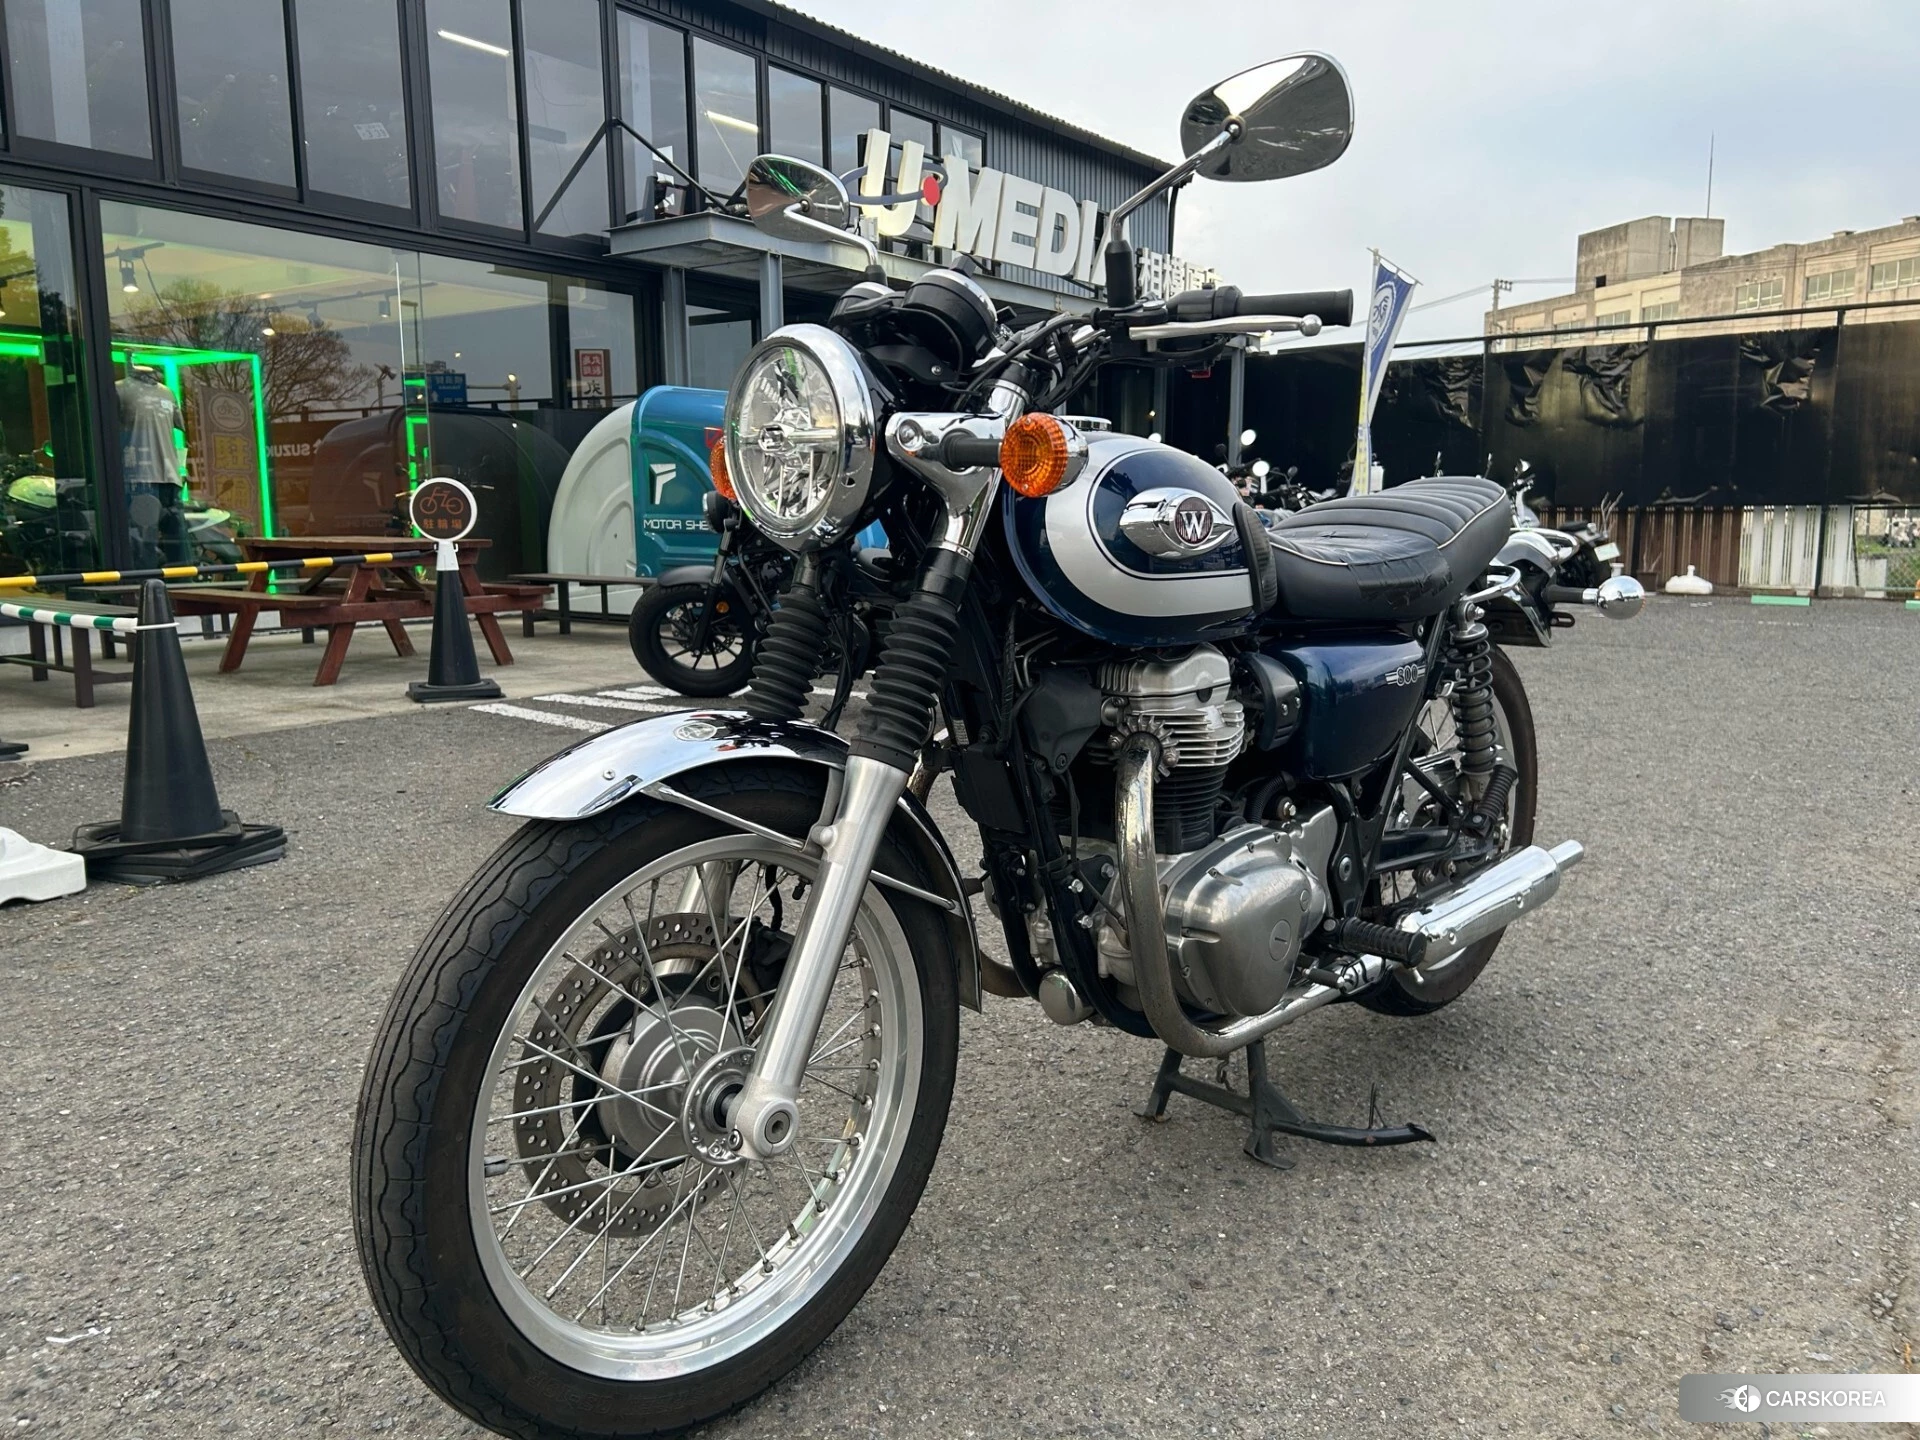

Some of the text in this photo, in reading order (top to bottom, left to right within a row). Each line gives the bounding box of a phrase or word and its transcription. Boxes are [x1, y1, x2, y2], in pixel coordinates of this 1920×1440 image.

[643, 519, 682, 530] MOTOR
[1180, 511, 1208, 540] W
[1396, 663, 1418, 687] 800
